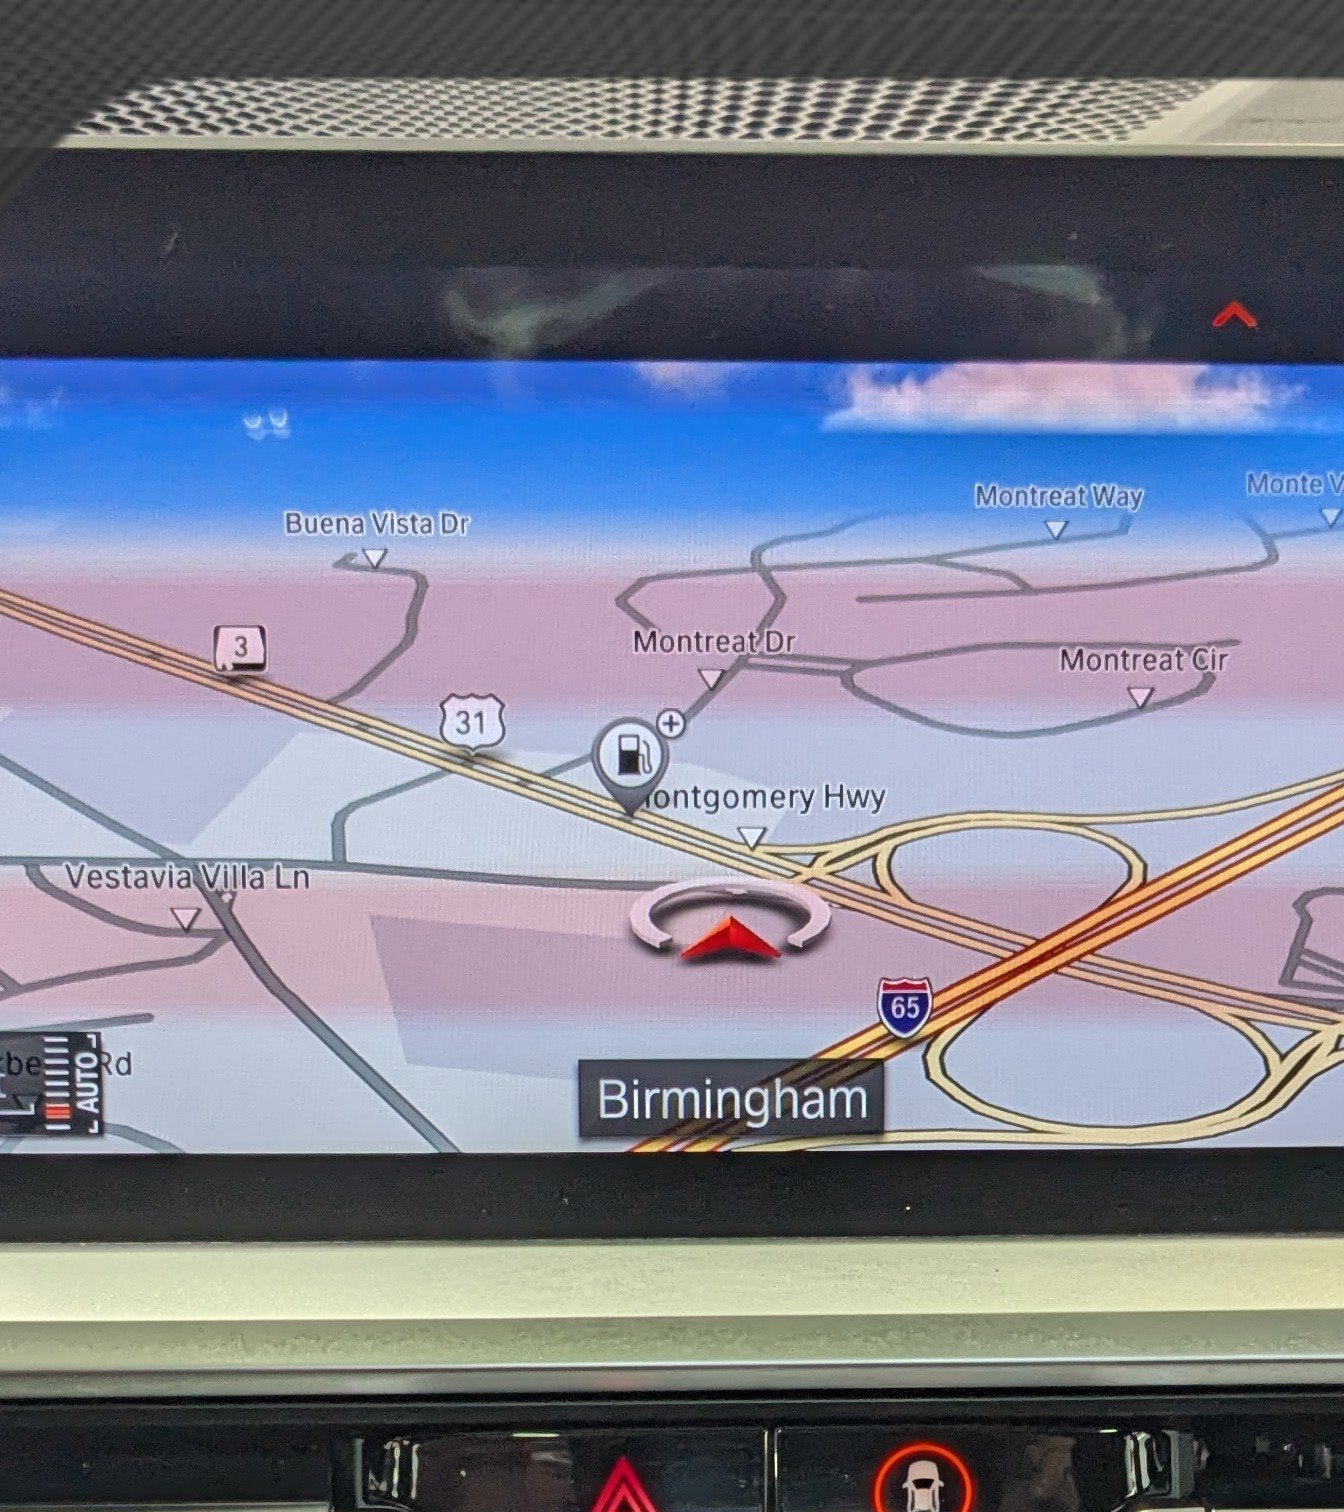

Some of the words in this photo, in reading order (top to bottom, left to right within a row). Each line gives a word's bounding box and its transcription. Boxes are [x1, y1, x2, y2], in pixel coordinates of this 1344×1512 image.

[1247, 473, 1323, 496] Monte
[975, 485, 1078, 508] Montreat
[1083, 485, 1143, 513] Way
[286, 512, 364, 534] Buena
[372, 512, 432, 534] Vista
[441, 512, 469, 534] Dr
[234, 636, 248, 657] 3
[633, 630, 758, 654] Montreat
[765, 630, 796, 654] Dr
[1061, 648, 1185, 673] Montreat
[1192, 648, 1229, 672] Cir
[456, 711, 486, 735] 31
[824, 784, 885, 815] Hwy
[65, 864, 192, 890] Vestavia
[200, 864, 265, 890] Villa
[274, 864, 311, 890] Ln
[890, 996, 920, 1019] 65
[75, 1051, 100, 1114] AUTO
[598, 1079, 869, 1128] Birmingham
